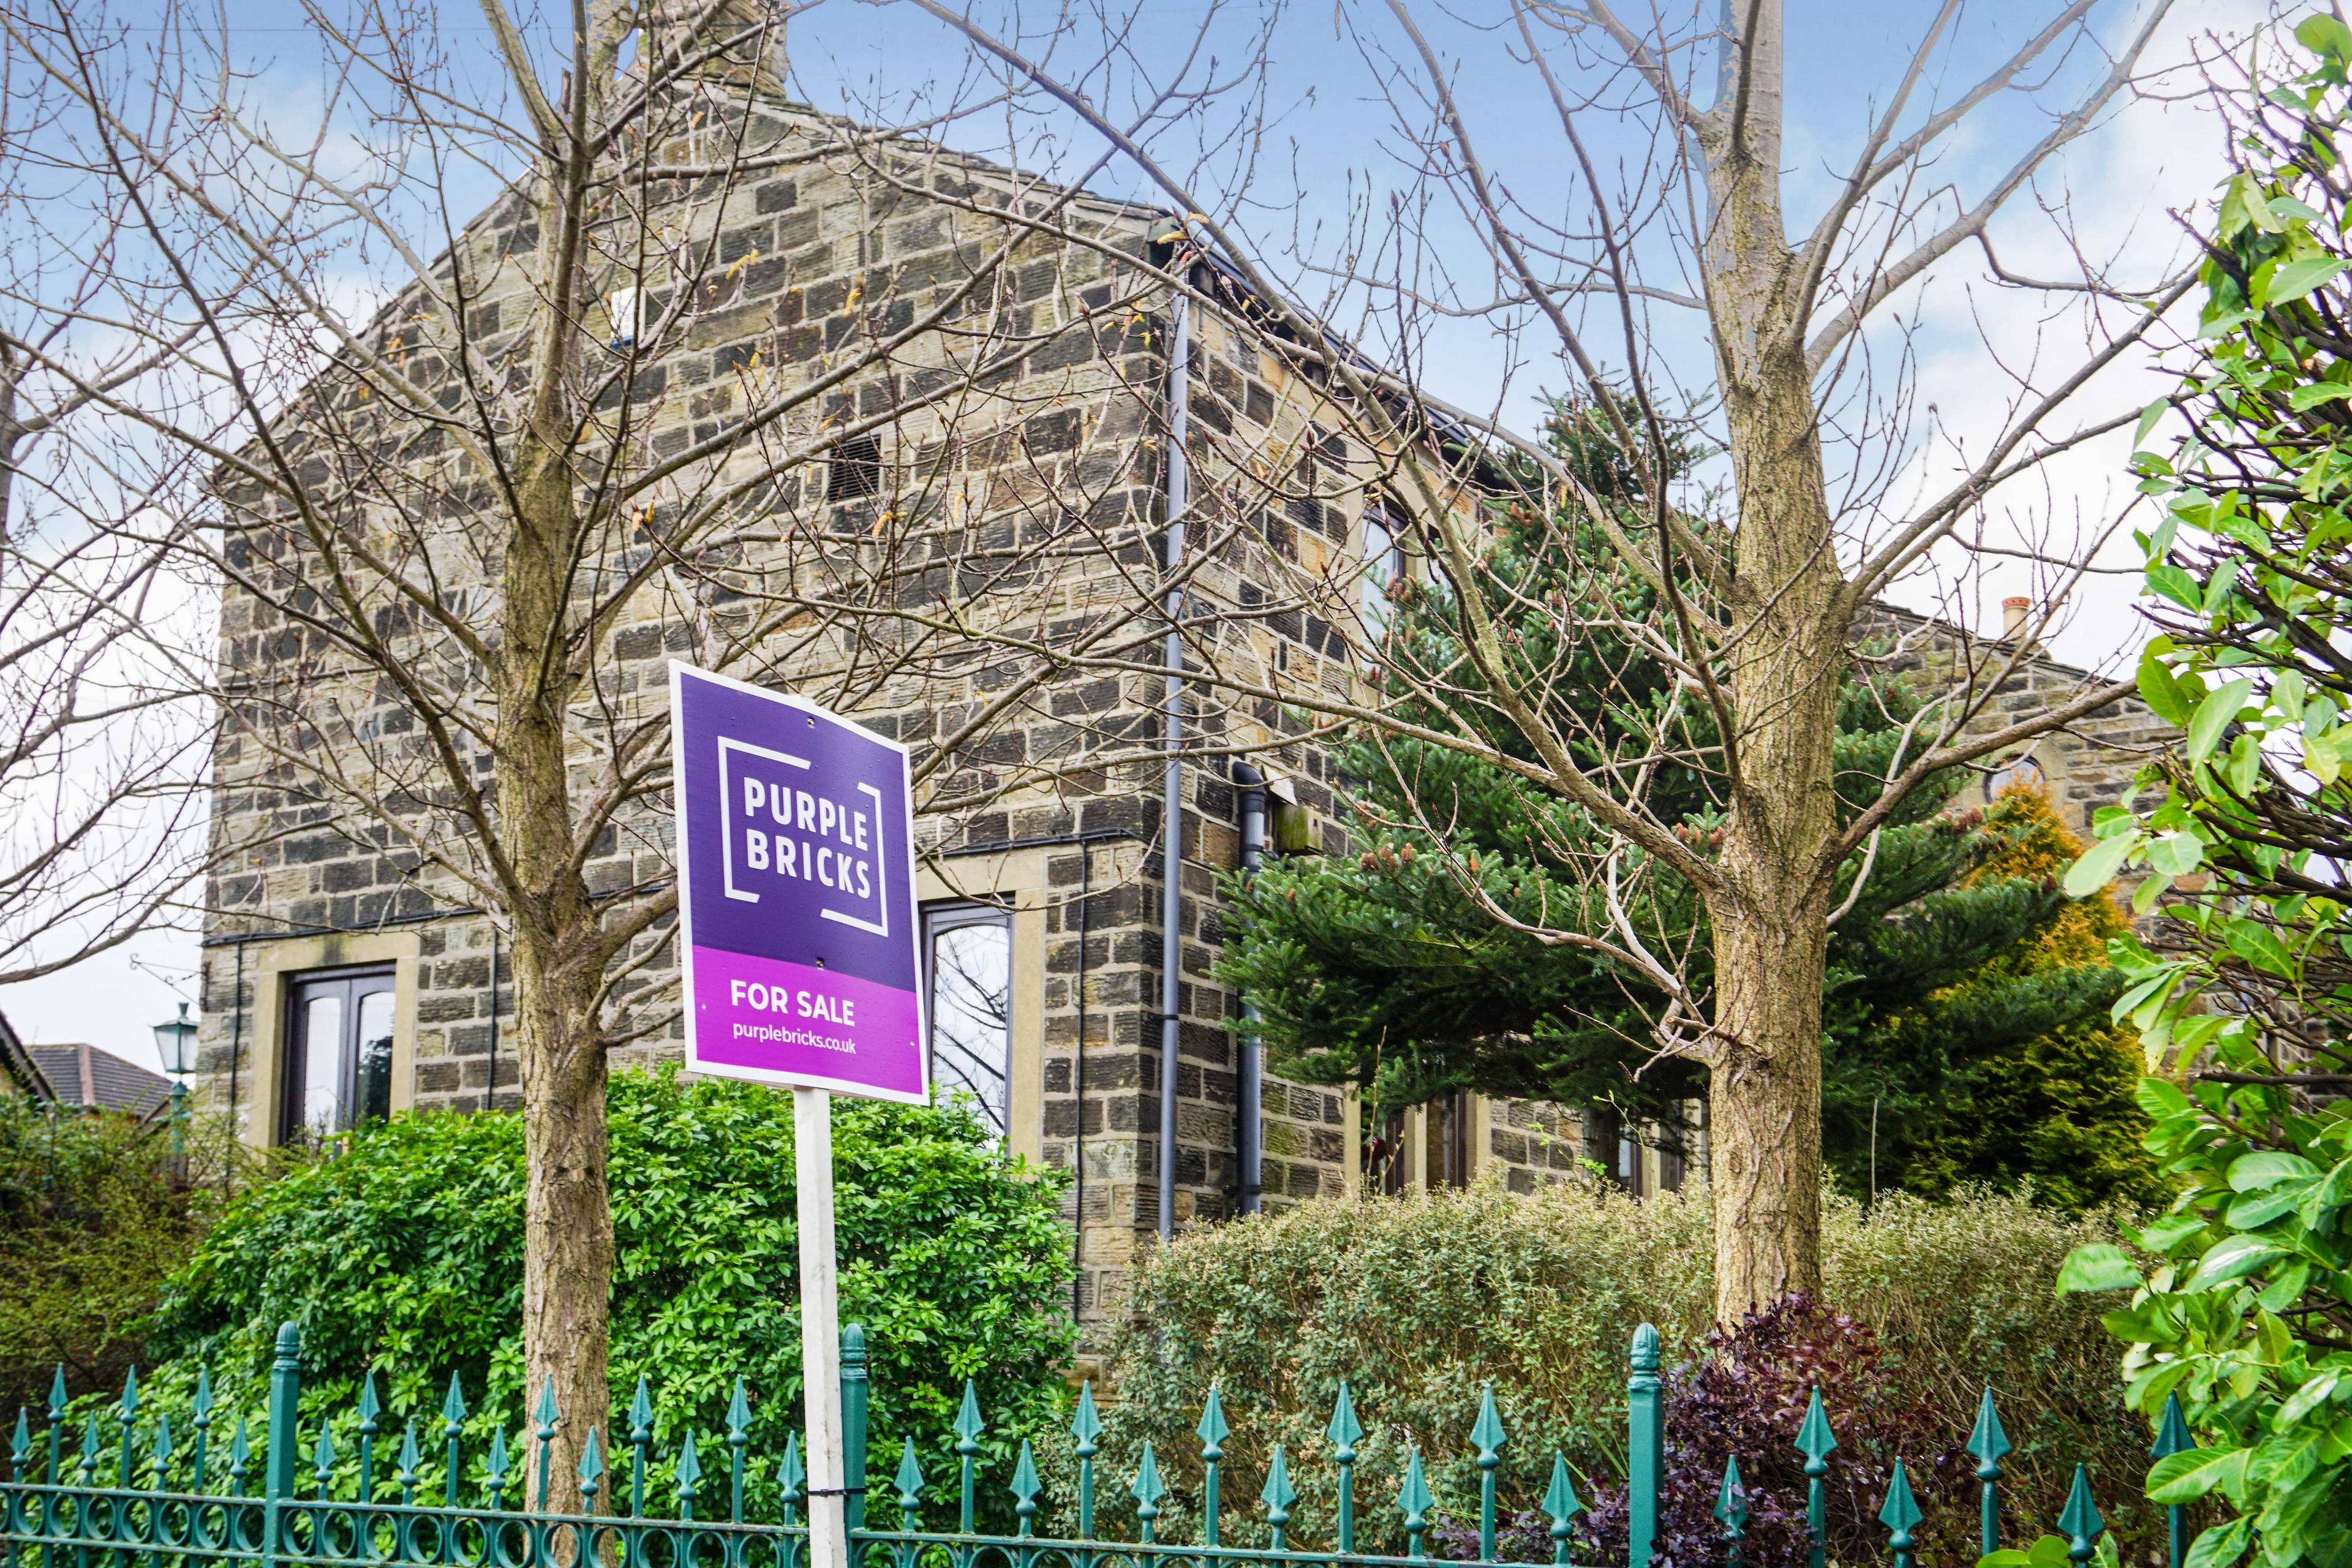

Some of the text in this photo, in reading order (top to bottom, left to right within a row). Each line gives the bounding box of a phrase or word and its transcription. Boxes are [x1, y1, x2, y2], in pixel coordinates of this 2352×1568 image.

[744, 777, 869, 851] PURPLE
[746, 828, 871, 899] BRICKS
[731, 979, 856, 1027] FOR SALE
[733, 1023, 856, 1055] purplebricks.co.uk
